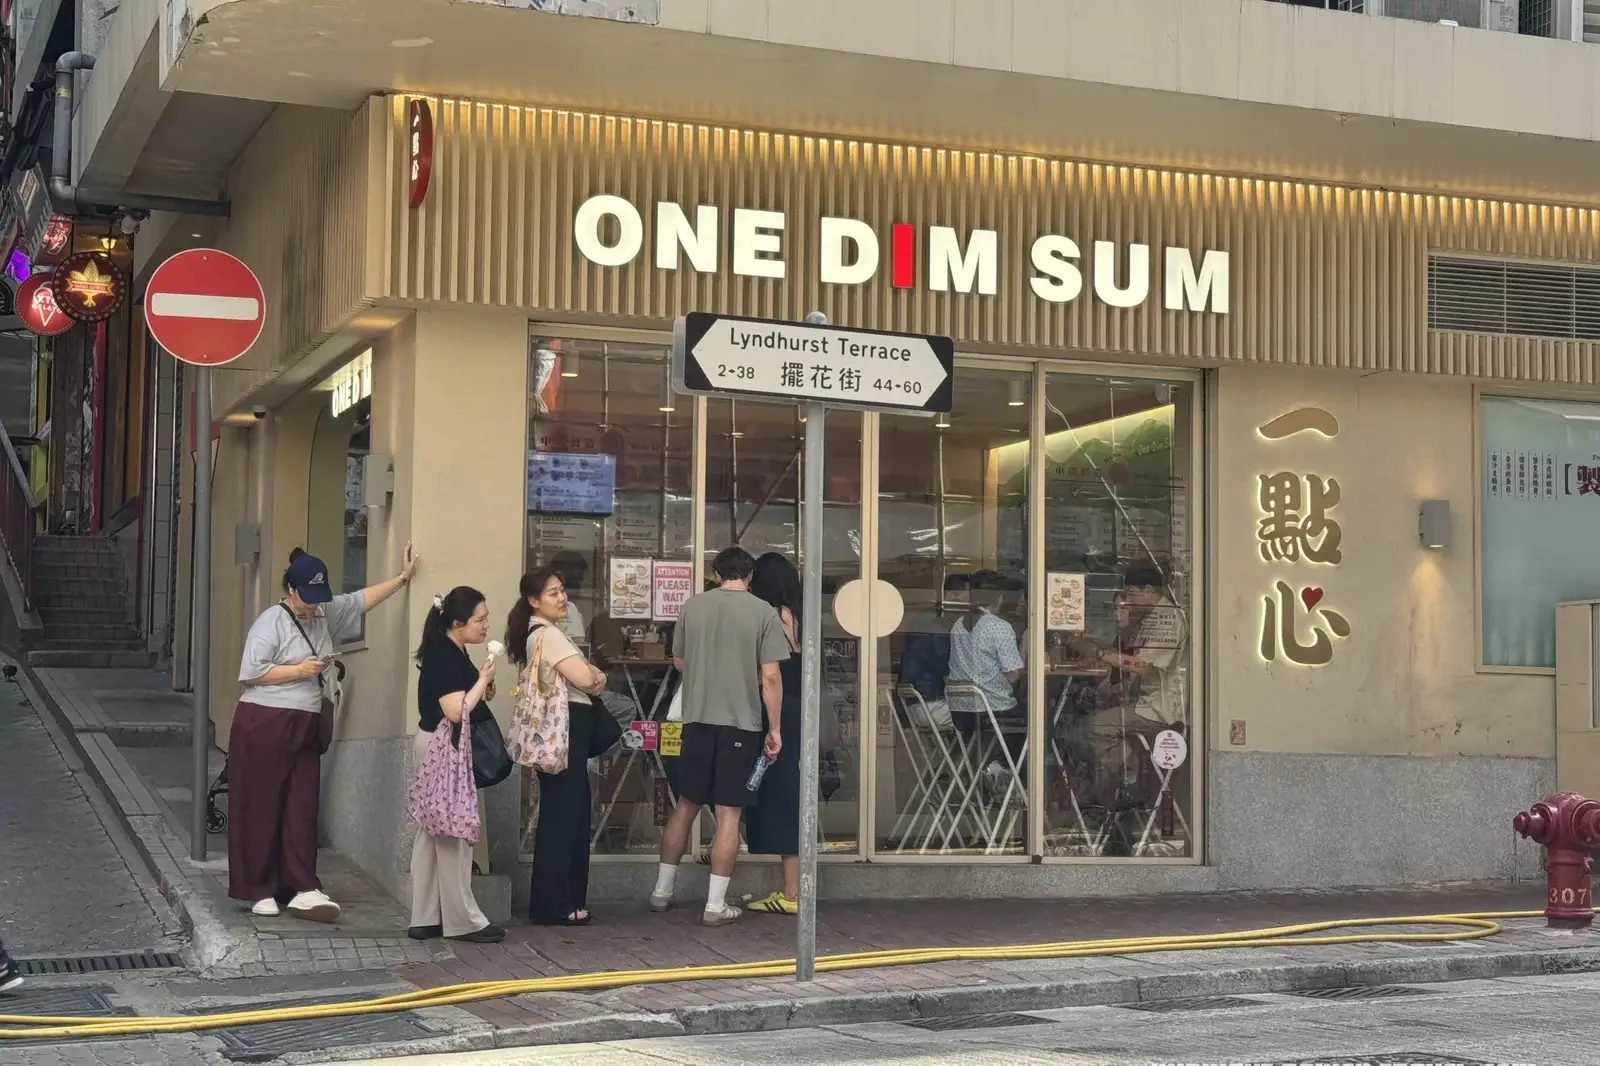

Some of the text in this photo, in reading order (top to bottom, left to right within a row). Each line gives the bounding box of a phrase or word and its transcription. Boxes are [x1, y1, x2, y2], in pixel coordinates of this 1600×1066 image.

[576, 196, 1229, 314] ONE DIM SUM
[730, 327, 911, 362] Lyndhurst Terrace
[780, 361, 861, 393] 擺花街
[332, 374, 352, 418] ONE
[1256, 406, 1351, 666] 一點心
[656, 567, 690, 577] ATTENTION
[657, 580, 690, 591] PLEASE
[662, 592, 685, 602] WAIT
[661, 604, 683, 615] HER
[1549, 886, 1588, 906] 307
